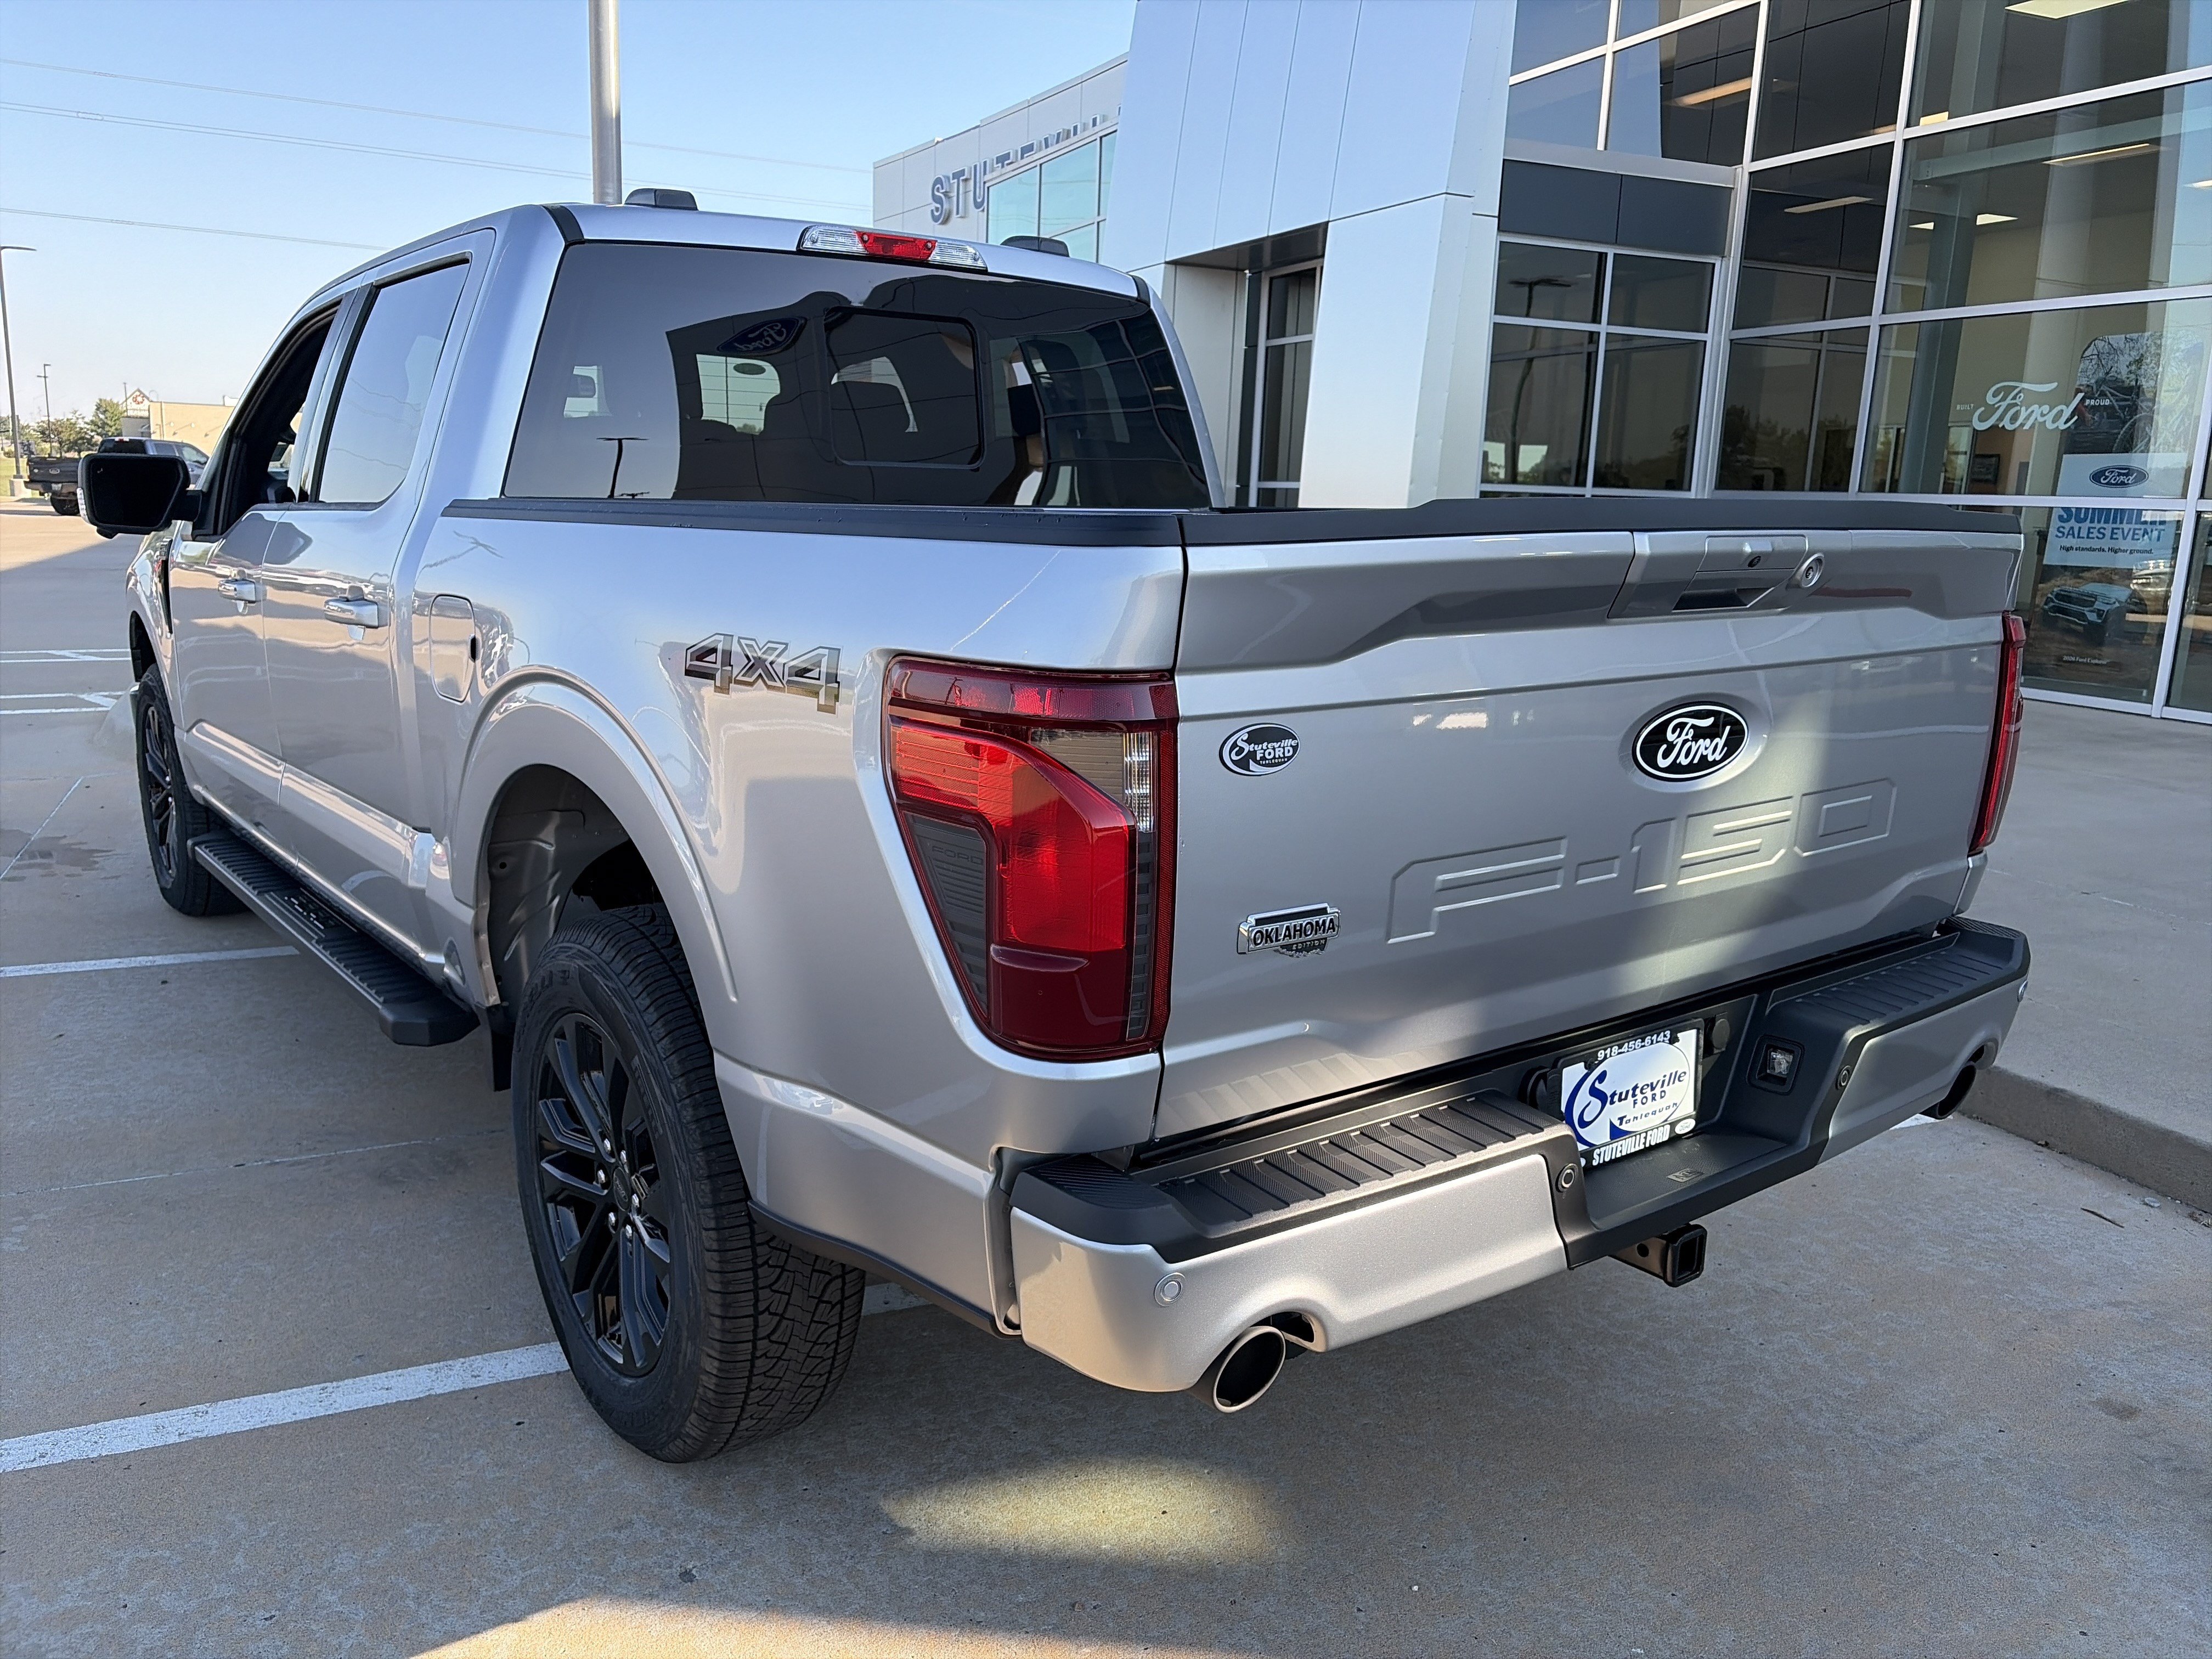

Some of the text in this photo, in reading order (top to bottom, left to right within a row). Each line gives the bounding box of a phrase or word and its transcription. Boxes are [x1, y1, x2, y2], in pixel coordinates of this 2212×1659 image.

[1972, 381, 2085, 431] Ford
[2100, 469, 2137, 484] Ford
[2058, 507, 2166, 526] SUMM
[2055, 526, 2165, 542] SALES EVENT
[1231, 733, 1299, 760] Stuteville
[1256, 747, 1293, 760] FORD
[1657, 716, 1729, 768] Ford
[932, 845, 984, 865] FORD
[1386, 778, 1897, 944] F-150
[1252, 917, 1335, 947] OKLAHOMA
[1292, 939, 1326, 950] EDITION
[1597, 1030, 1671, 1060] 918-456-6143
[1577, 1070, 1687, 1129] Stuteville
[1633, 1090, 1667, 1109] FORD
[1617, 1102, 1678, 1127] Tahlequah
[1592, 1124, 1671, 1166] STUTEVILLE FORD
